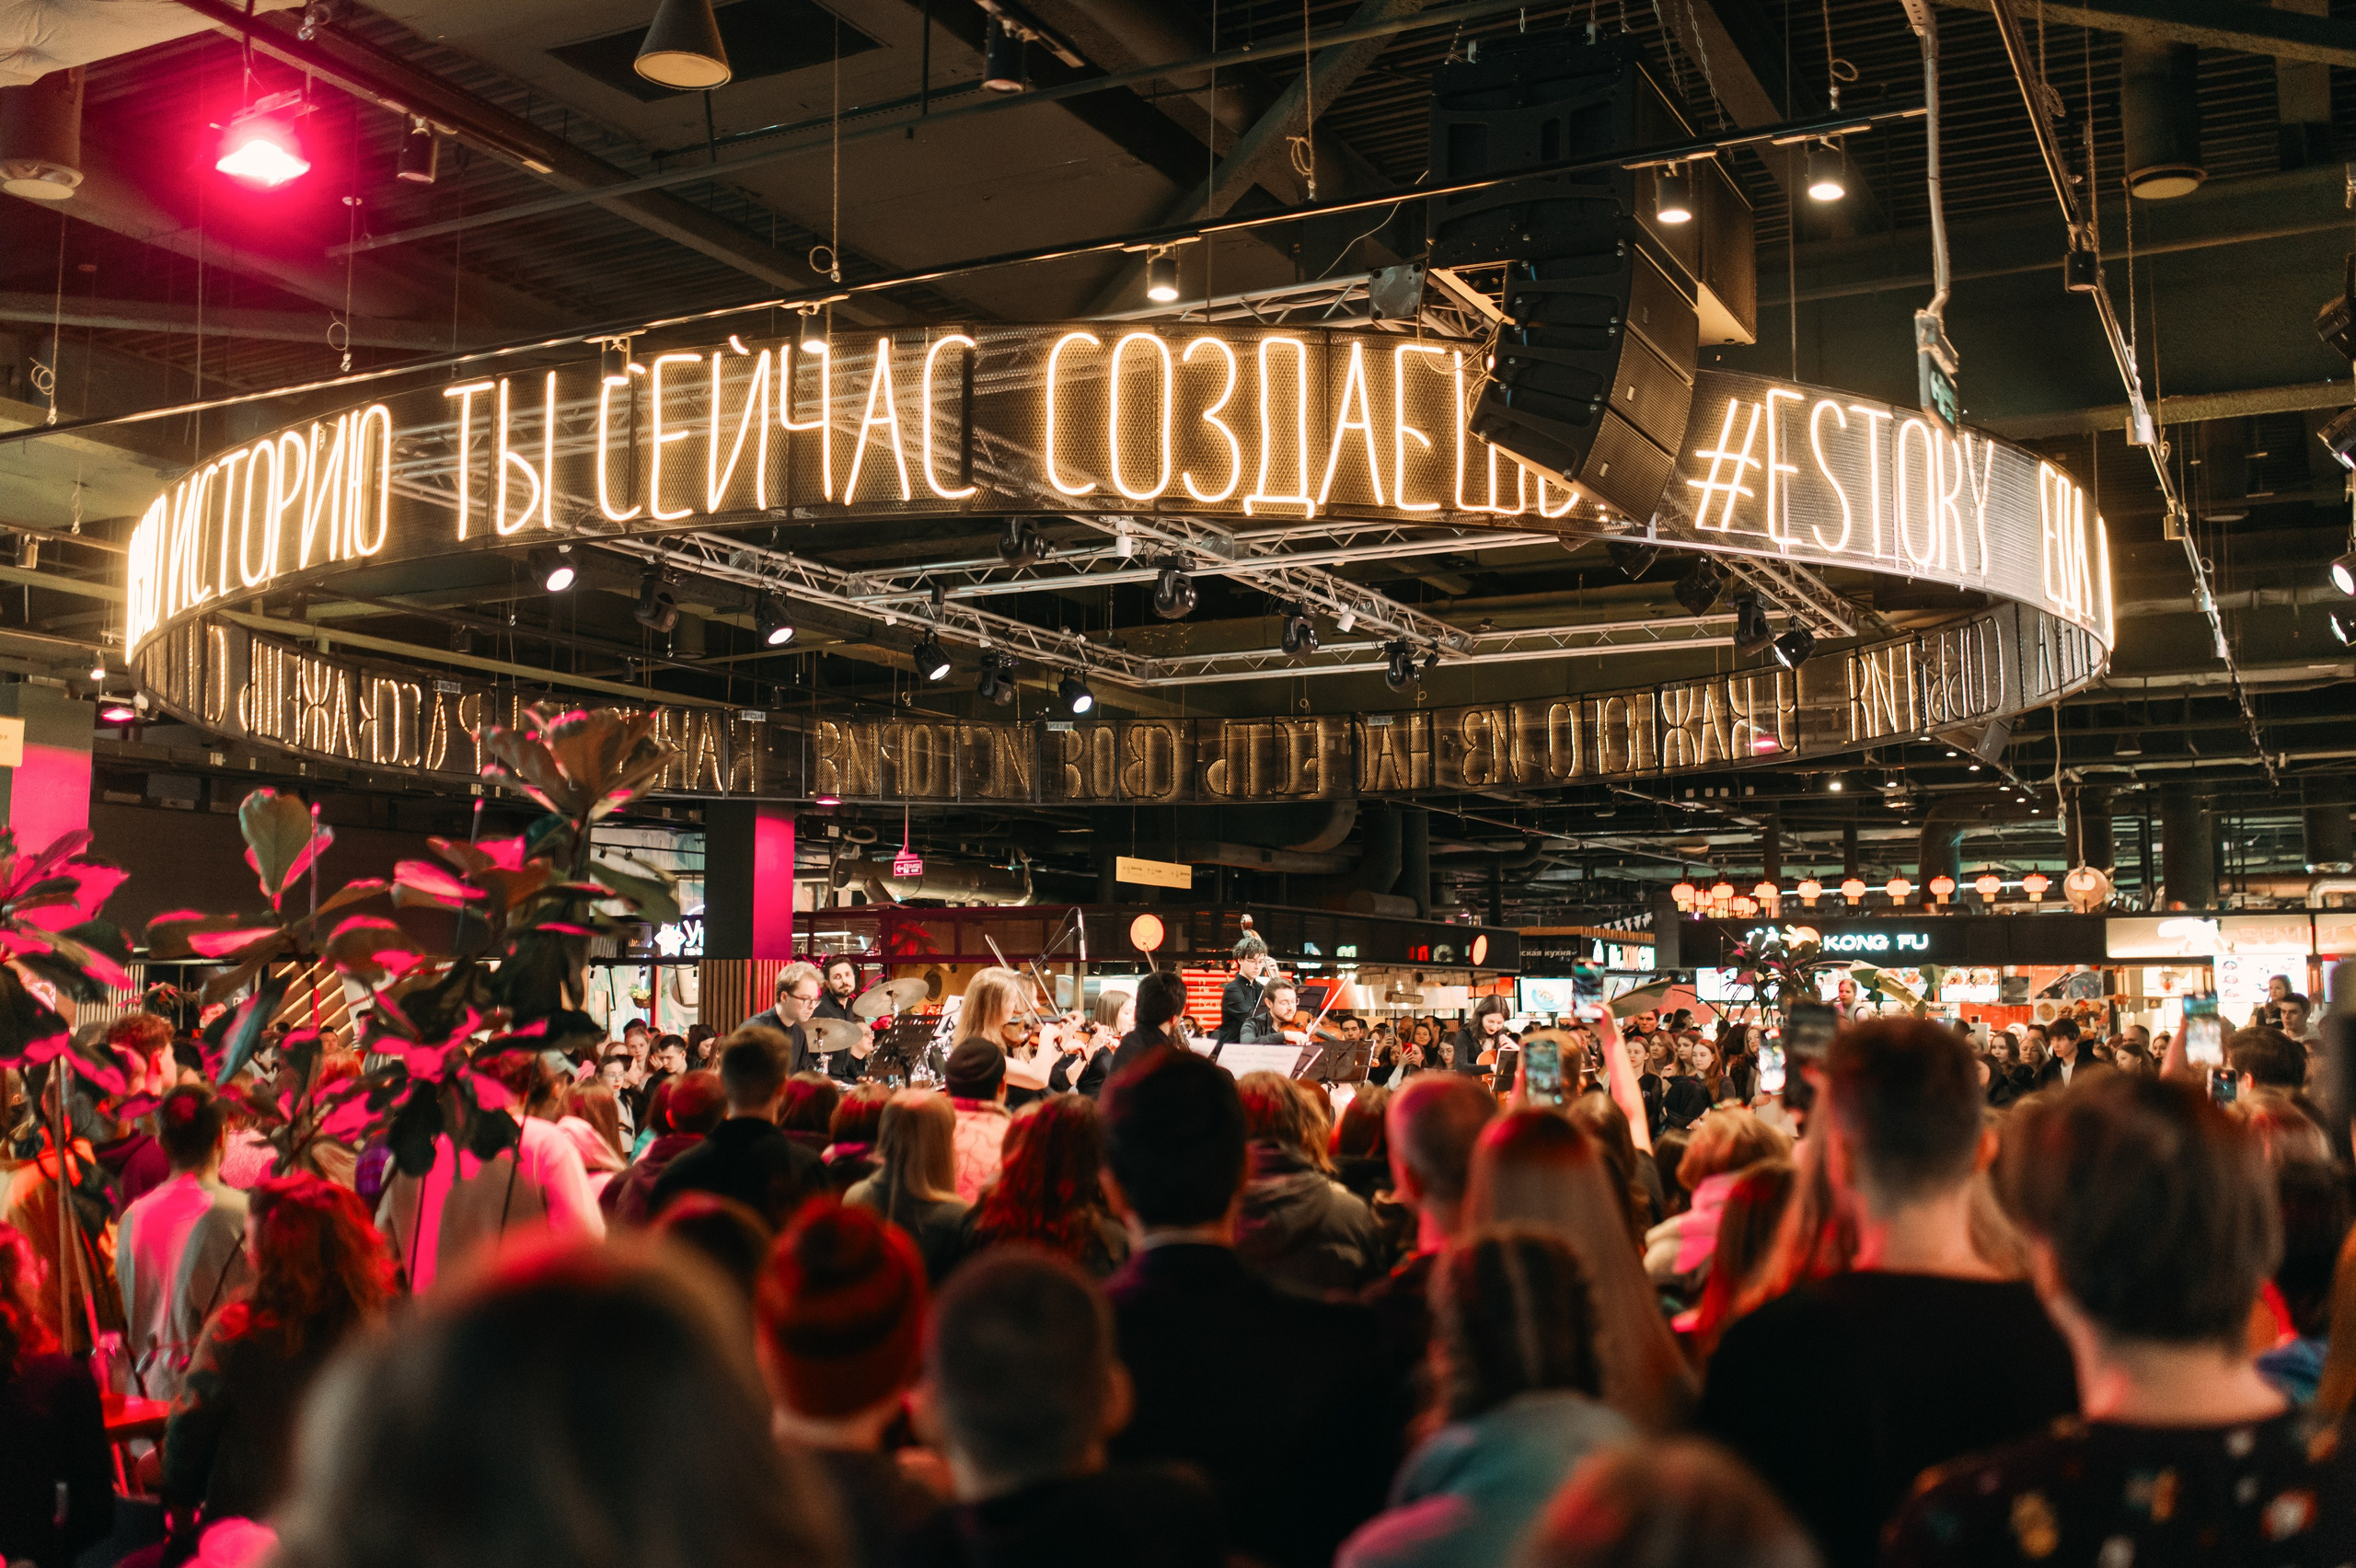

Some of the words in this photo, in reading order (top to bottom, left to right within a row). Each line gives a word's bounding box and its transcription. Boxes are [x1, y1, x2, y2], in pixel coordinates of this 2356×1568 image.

[167, 403, 392, 619] ИСТОРИЮ
[444, 370, 557, 541] ТЫ
[597, 333, 978, 522] СЕЙЧАС
[1045, 330, 1581, 518] СОЗДАЕШ
[1687, 387, 1995, 577] #ESTORY
[1544, 950, 1571, 959] кухня
[1823, 934, 1890, 951] KONG
[1897, 933, 1929, 951] FU
